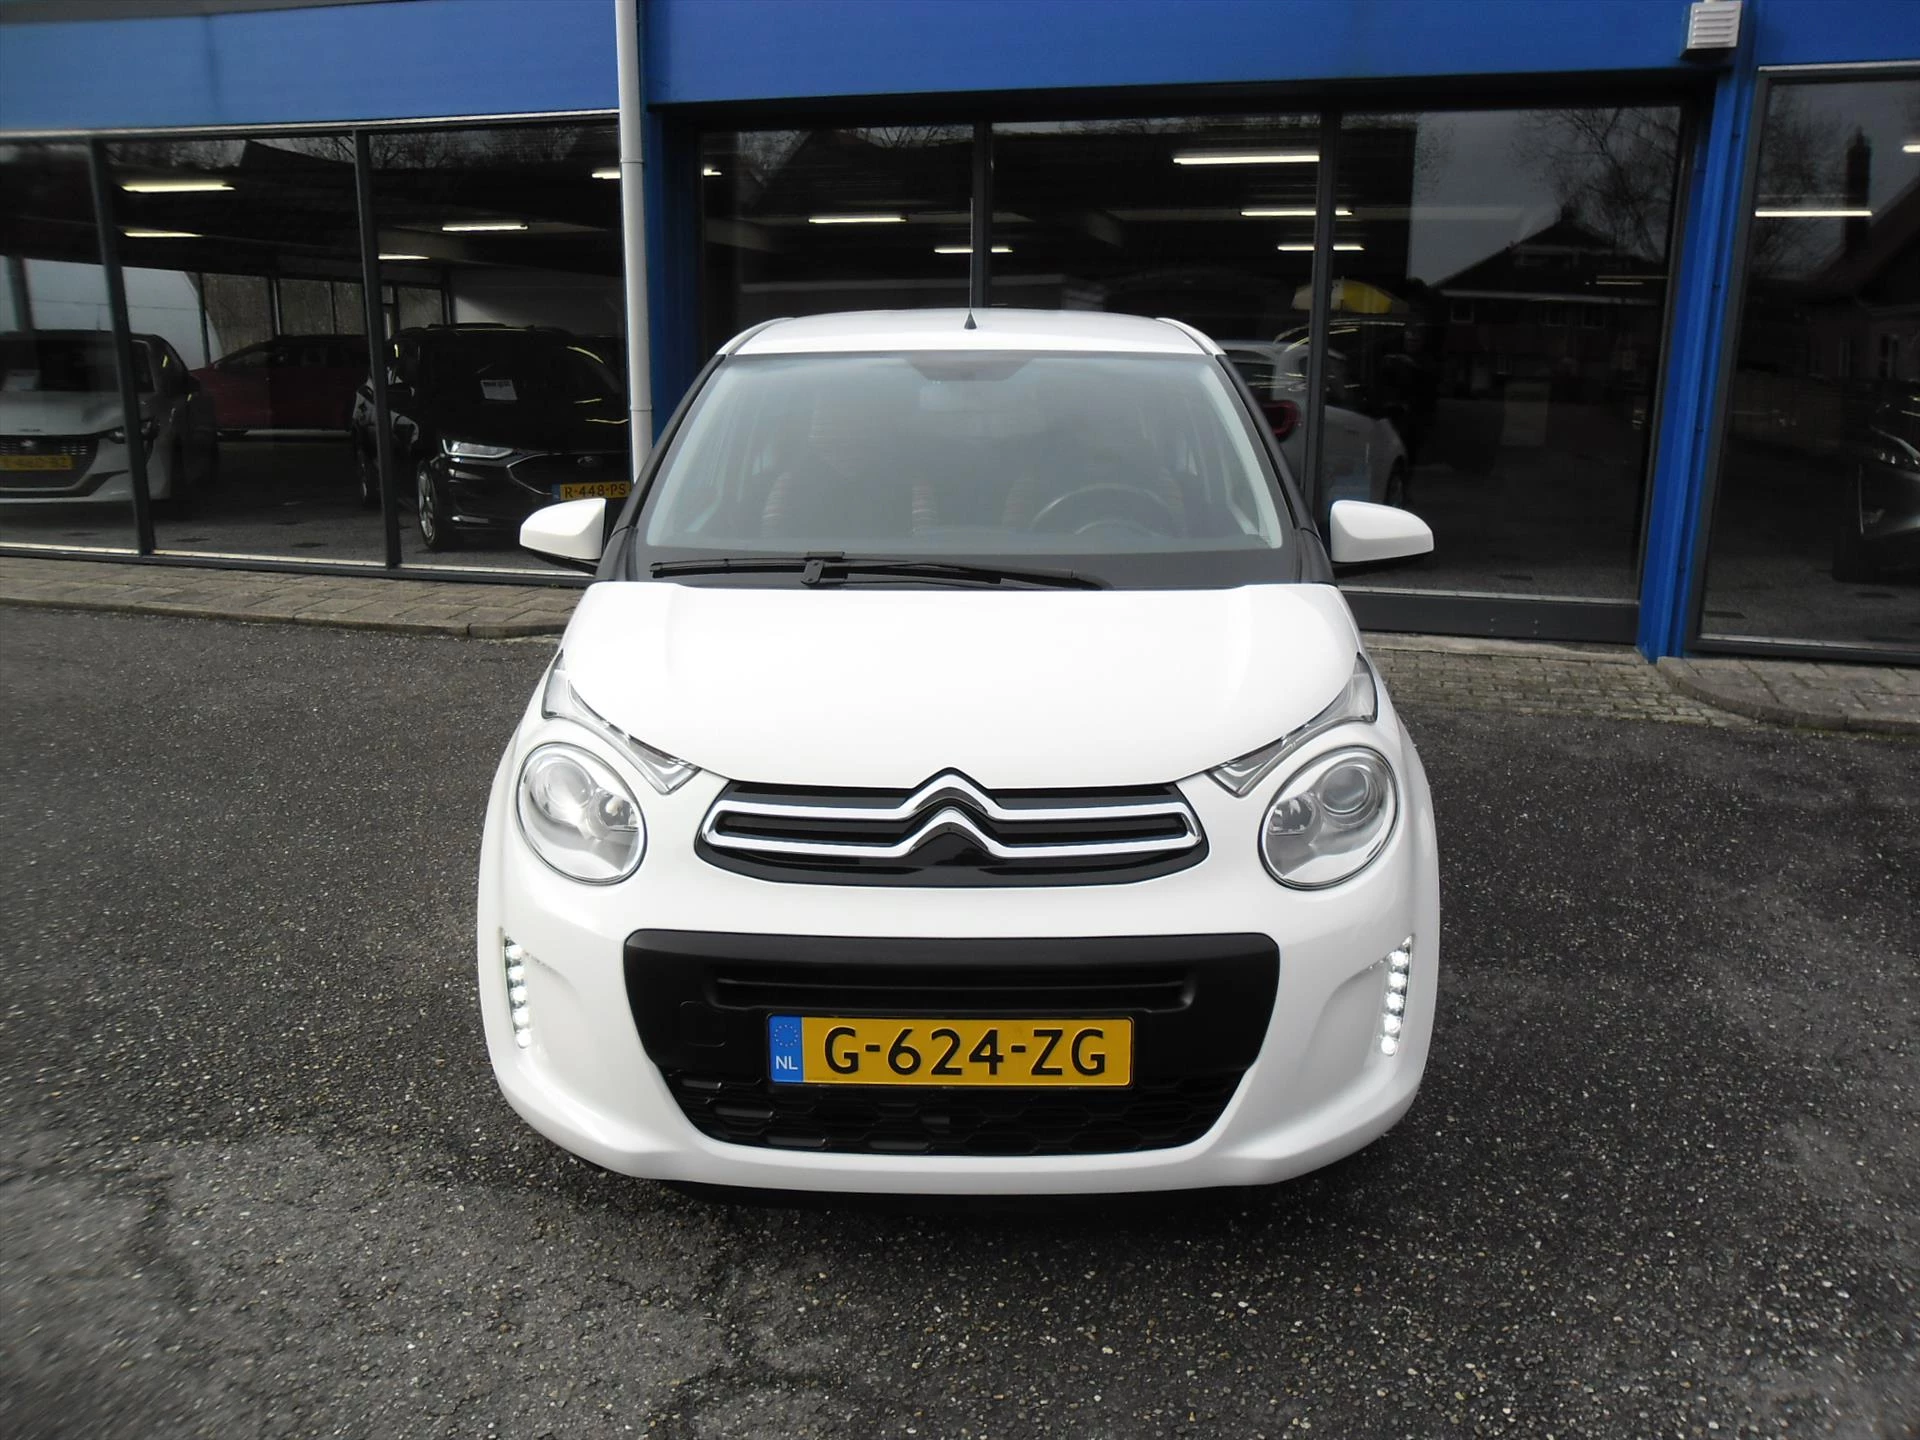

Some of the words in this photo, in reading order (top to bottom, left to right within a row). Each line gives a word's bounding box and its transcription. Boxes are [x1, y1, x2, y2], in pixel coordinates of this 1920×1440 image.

[564, 483, 626, 498] R-448-PS
[823, 1026, 1106, 1076] G-624-ZG
[775, 1055, 798, 1070] NL
